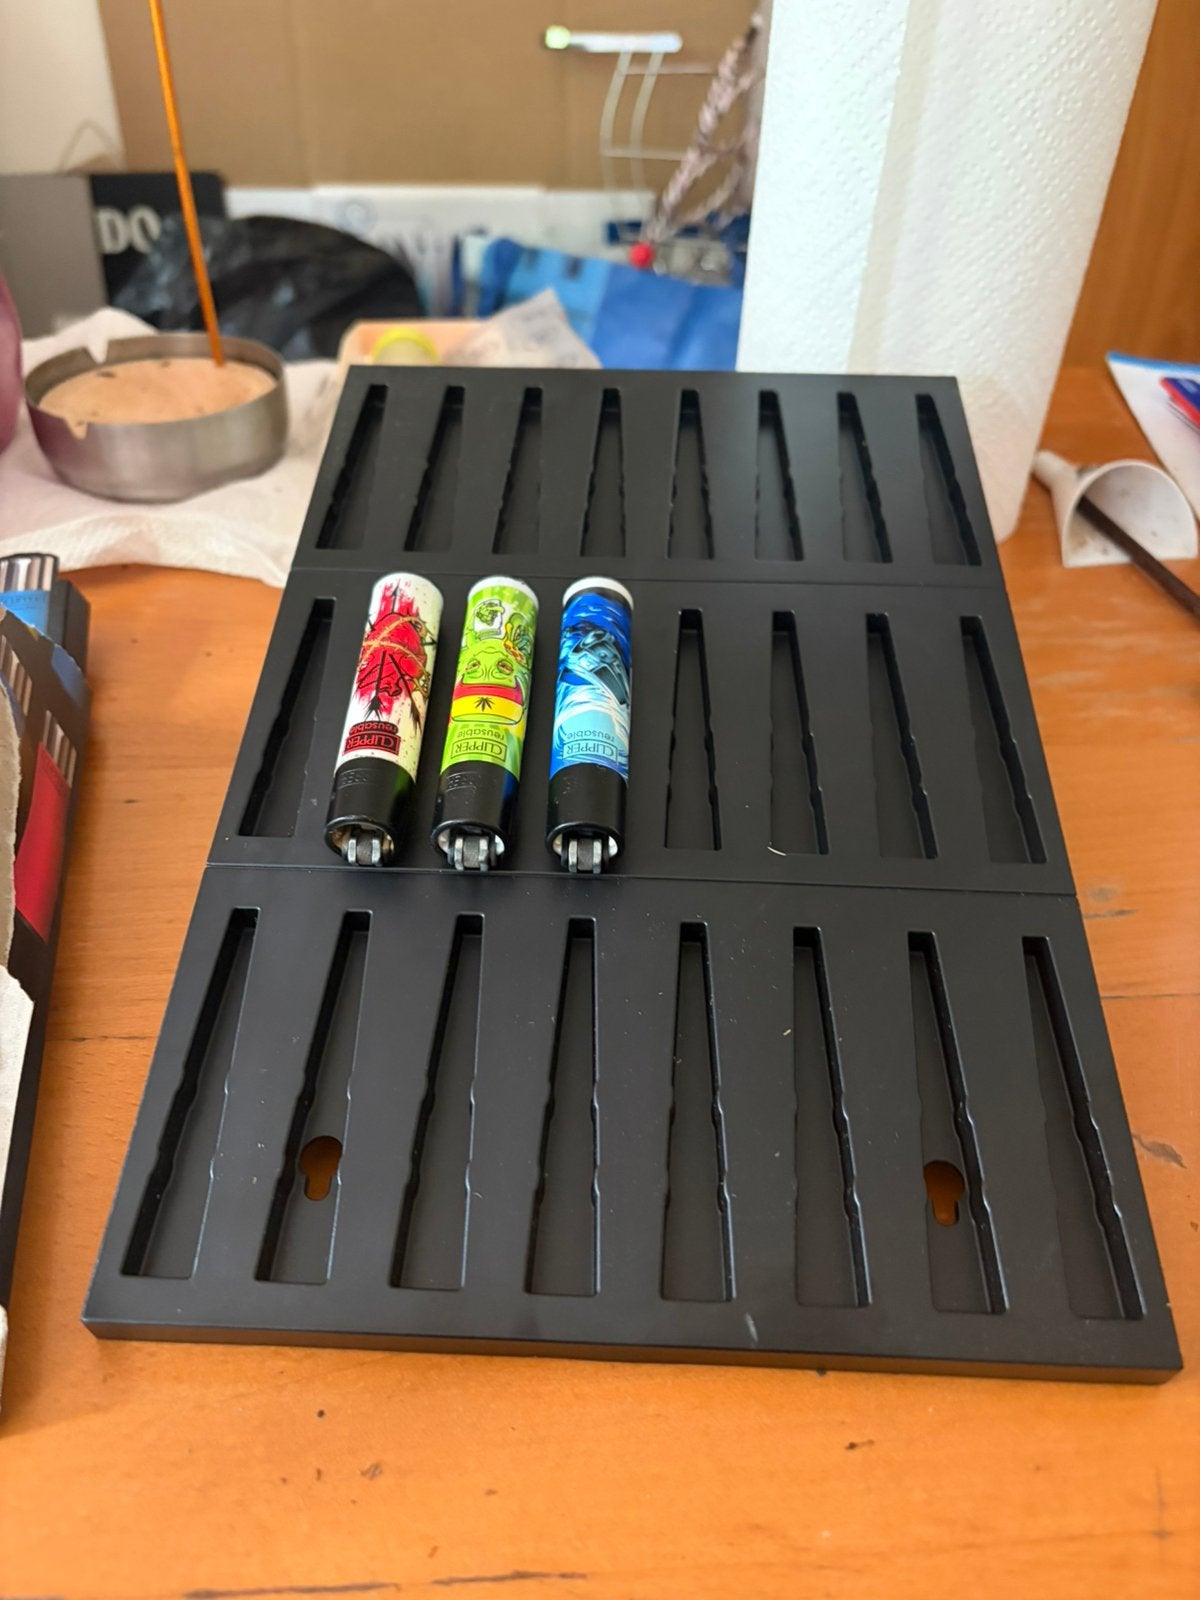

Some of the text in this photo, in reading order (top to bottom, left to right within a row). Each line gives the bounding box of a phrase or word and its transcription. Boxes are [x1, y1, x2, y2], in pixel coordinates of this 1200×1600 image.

[350, 722, 397, 734] reusable
[457, 728, 505, 741] reusable
[347, 734, 395, 748] CLIPPER
[567, 730, 615, 742] reusable
[455, 741, 503, 755] CLIPPER
[566, 742, 614, 756] CLIPPER
